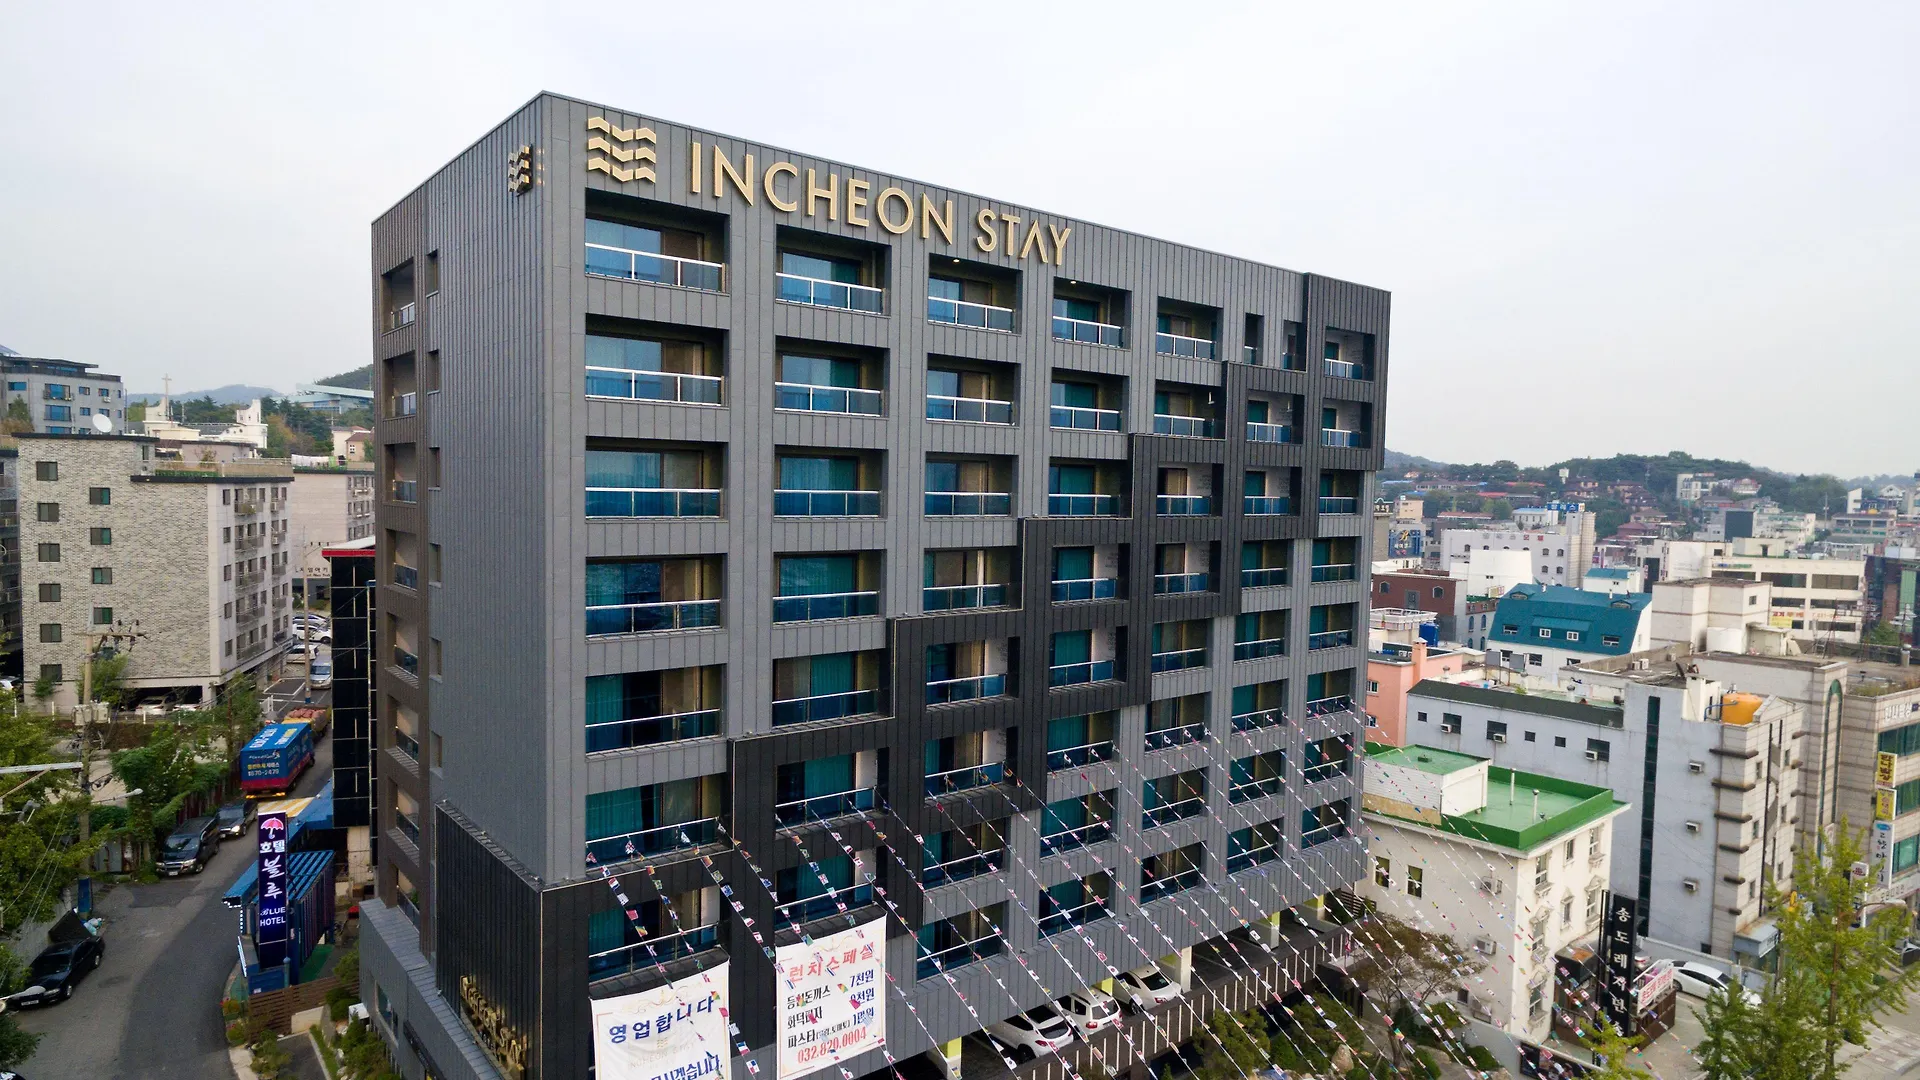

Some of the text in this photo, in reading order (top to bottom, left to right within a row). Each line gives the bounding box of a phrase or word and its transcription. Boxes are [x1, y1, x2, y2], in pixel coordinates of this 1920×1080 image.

[691, 142, 1072, 266] INCHEON STAY
[260, 840, 285, 853] 호텔
[260, 906, 286, 916] BLUE
[260, 916, 286, 926] HOTEL
[850, 969, 874, 988] 7천원
[609, 996, 715, 1044] 영업합니다
